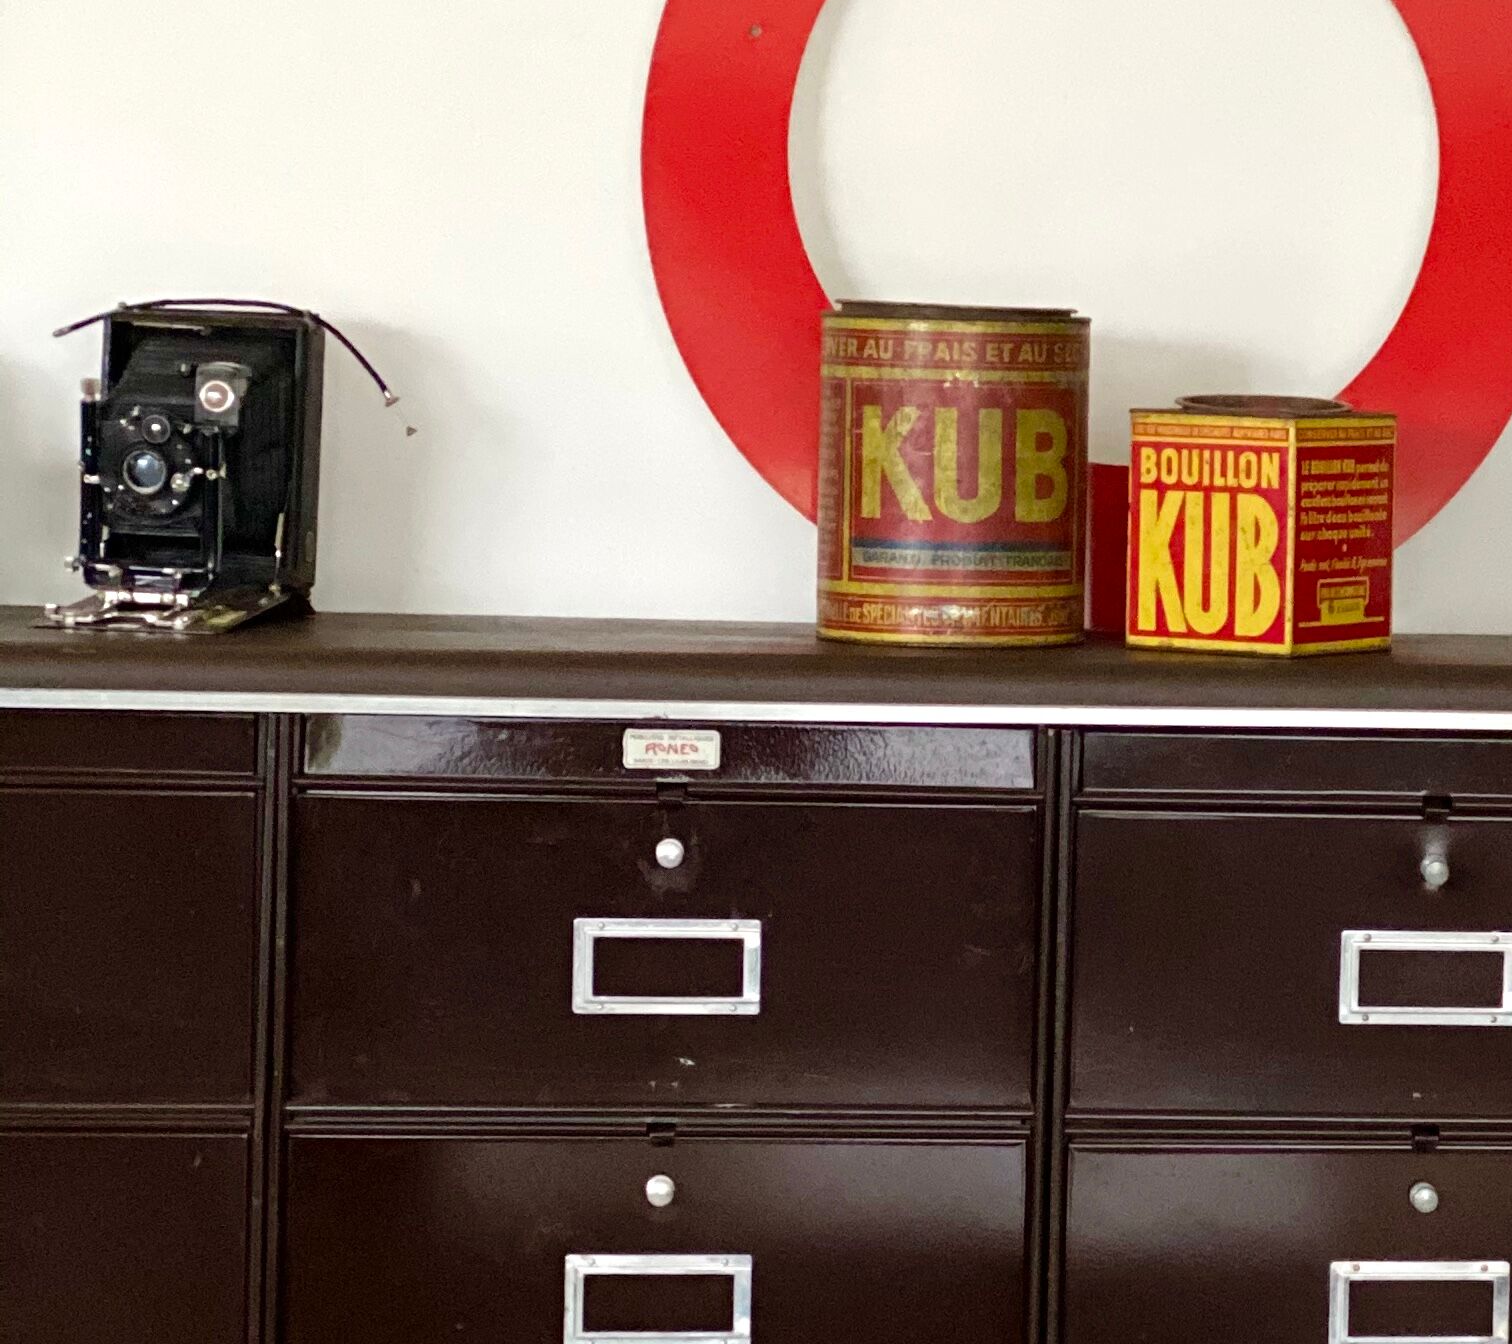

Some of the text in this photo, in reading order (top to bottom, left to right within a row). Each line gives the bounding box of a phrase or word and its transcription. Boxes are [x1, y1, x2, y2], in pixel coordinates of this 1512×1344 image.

[863, 337, 894, 359] AU
[985, 342, 1014, 363] ET
[1018, 342, 1048, 363] AU
[861, 405, 1068, 524] KUB
[1140, 446, 1280, 489] BOUILLON
[1137, 489, 1281, 638] KUB
[645, 742, 699, 756] RONEO
